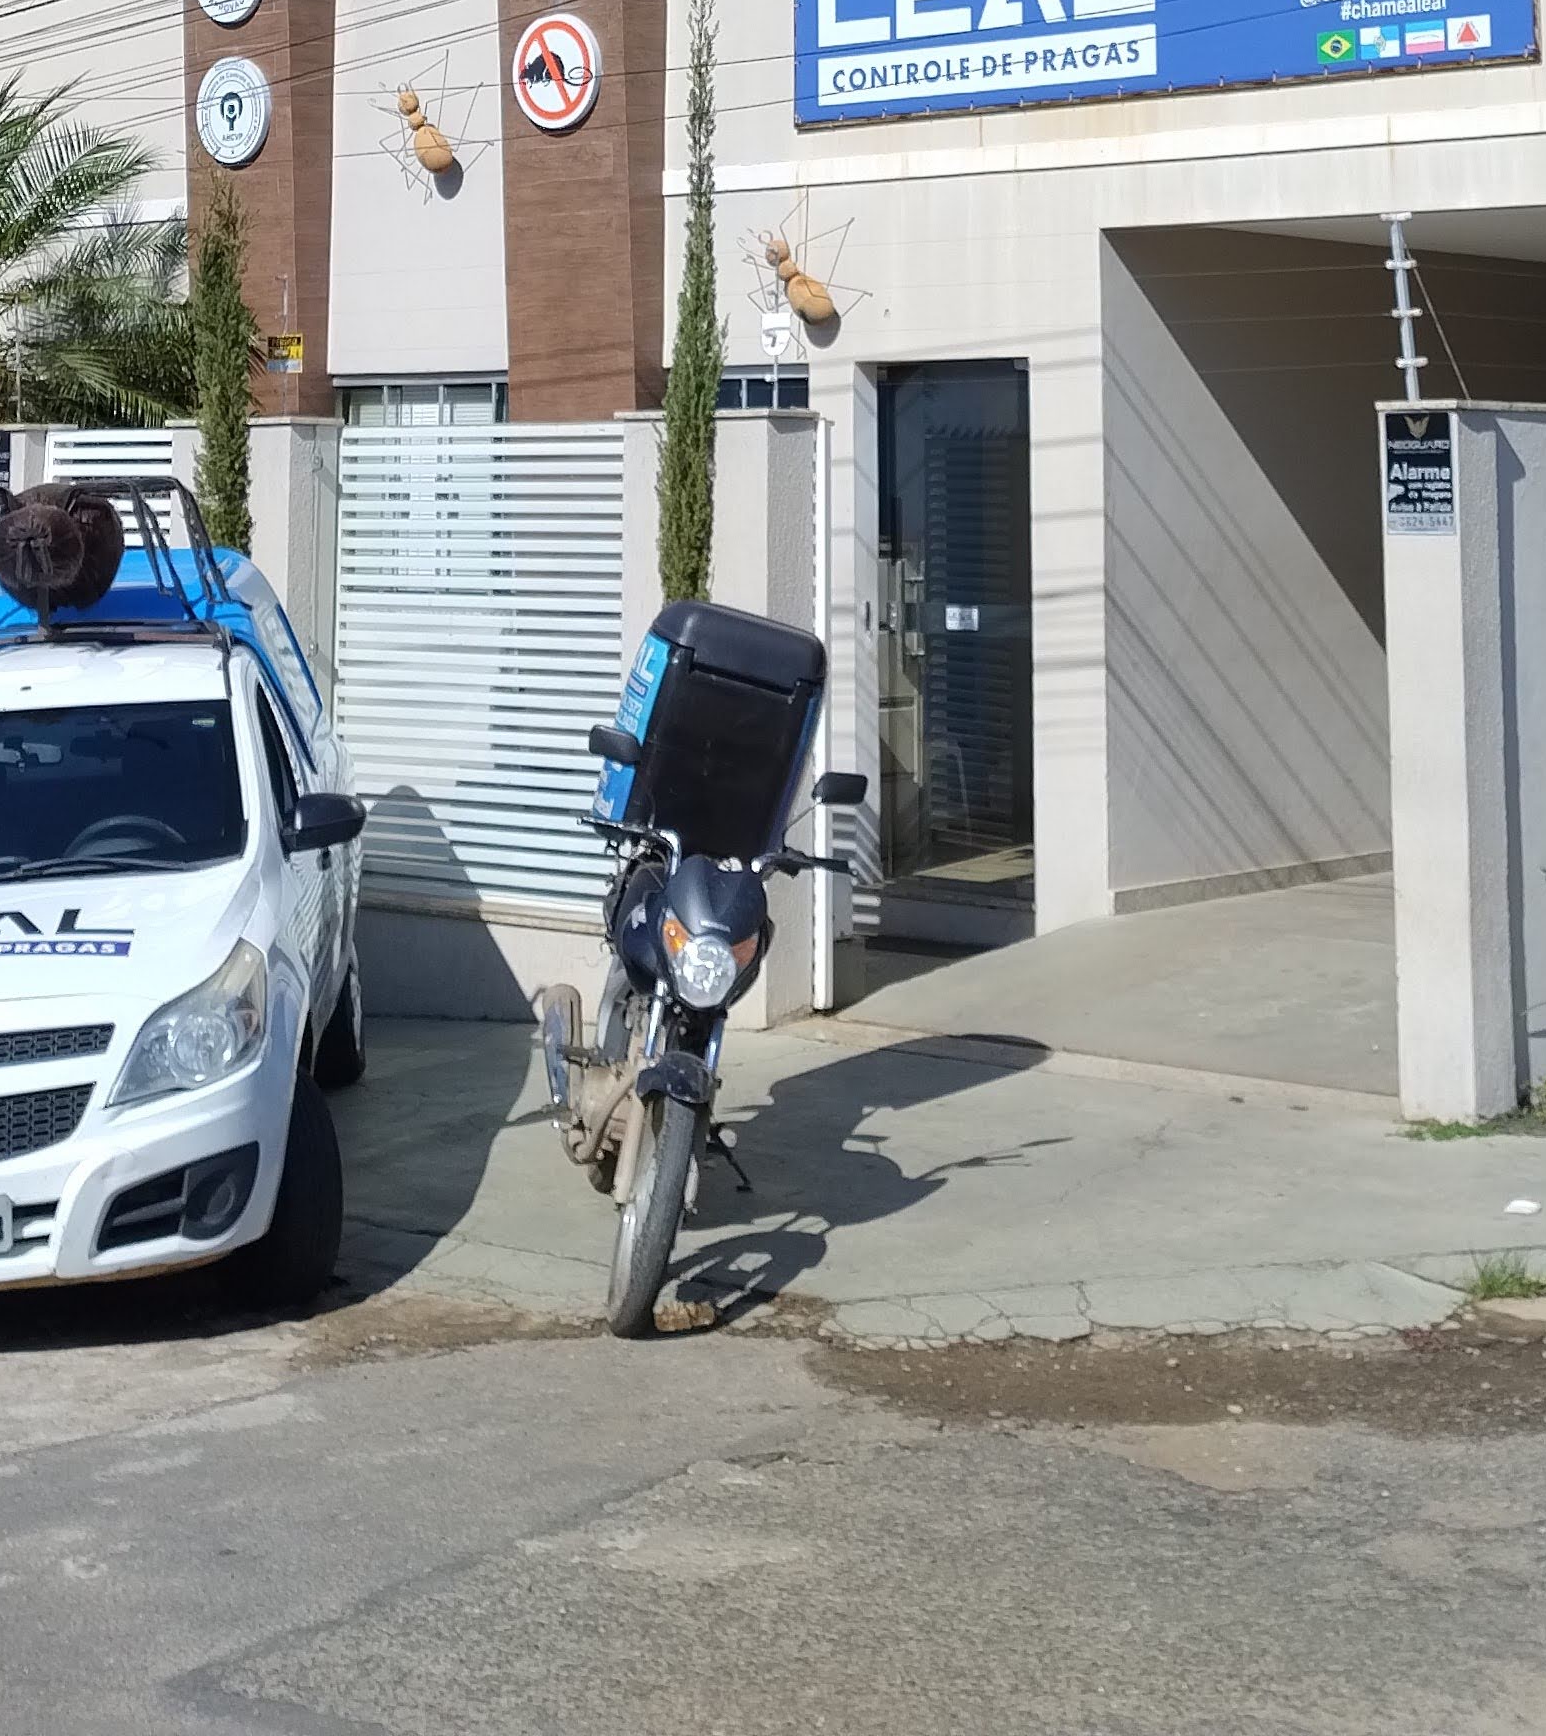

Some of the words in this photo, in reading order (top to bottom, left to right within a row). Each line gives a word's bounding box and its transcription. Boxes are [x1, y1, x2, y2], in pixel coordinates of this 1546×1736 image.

[832, 57, 970, 93] CONTROLE
[982, 52, 1013, 78] DE
[1025, 40, 1140, 73] PRAGAS
[1390, 462, 1451, 480] Alarme
